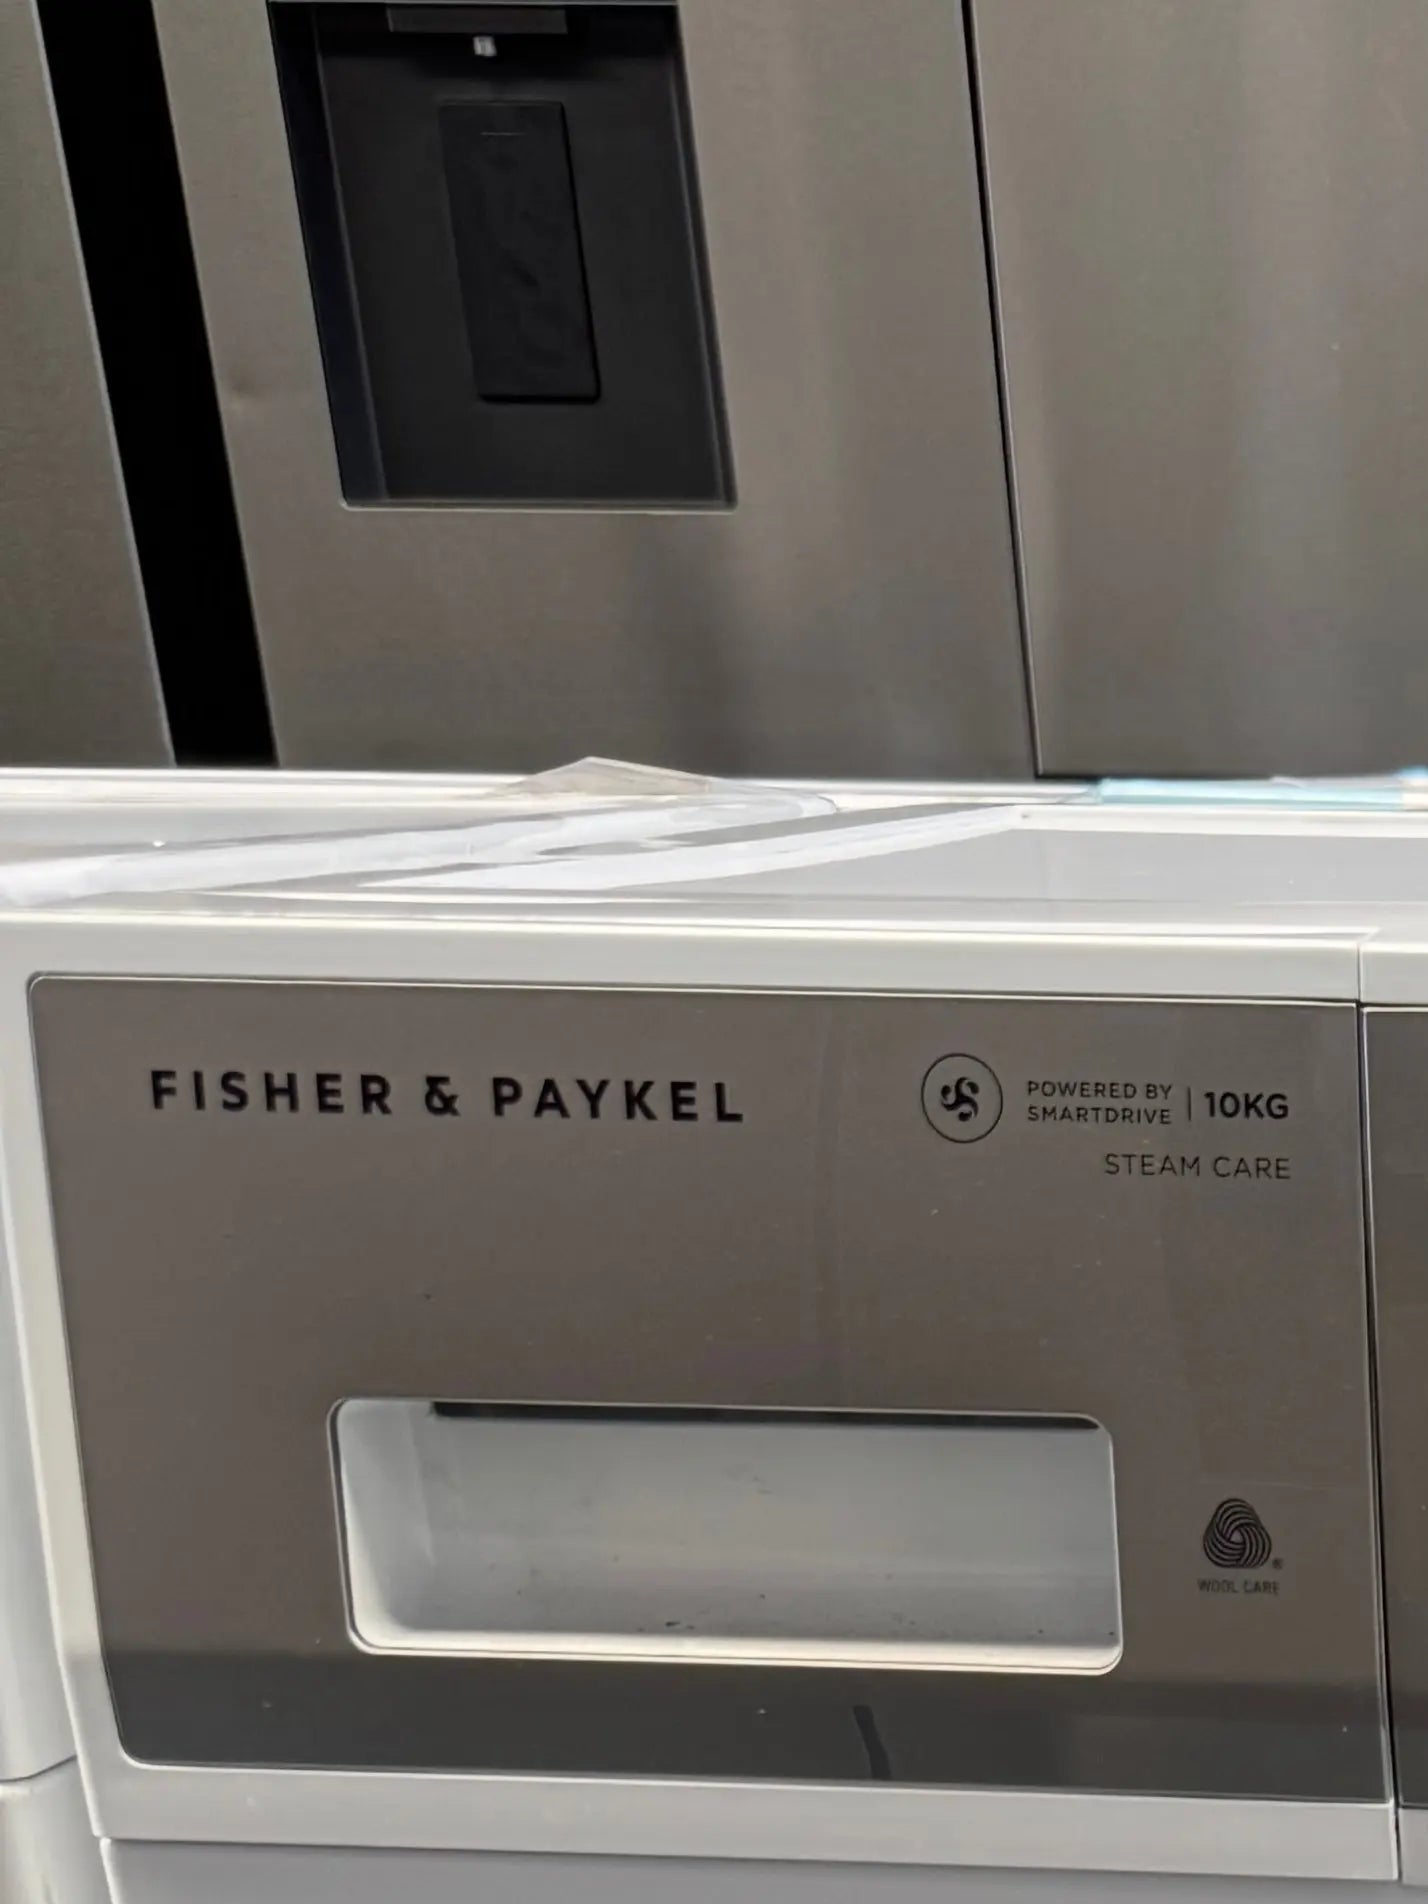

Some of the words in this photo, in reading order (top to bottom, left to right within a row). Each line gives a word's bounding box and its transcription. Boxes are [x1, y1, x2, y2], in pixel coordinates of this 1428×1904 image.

[151, 1070, 392, 1116] FISHER
[424, 1075, 460, 1117] &
[492, 1076, 743, 1123] PAYKEL
[1027, 1080, 1137, 1100] POWERED
[1146, 1083, 1173, 1100] BY
[1027, 1105, 1172, 1125] SMARTDRIVE
[1203, 1091, 1289, 1120] 10KG
[1104, 1153, 1200, 1177] STEAM
[1212, 1155, 1291, 1180] CARE
